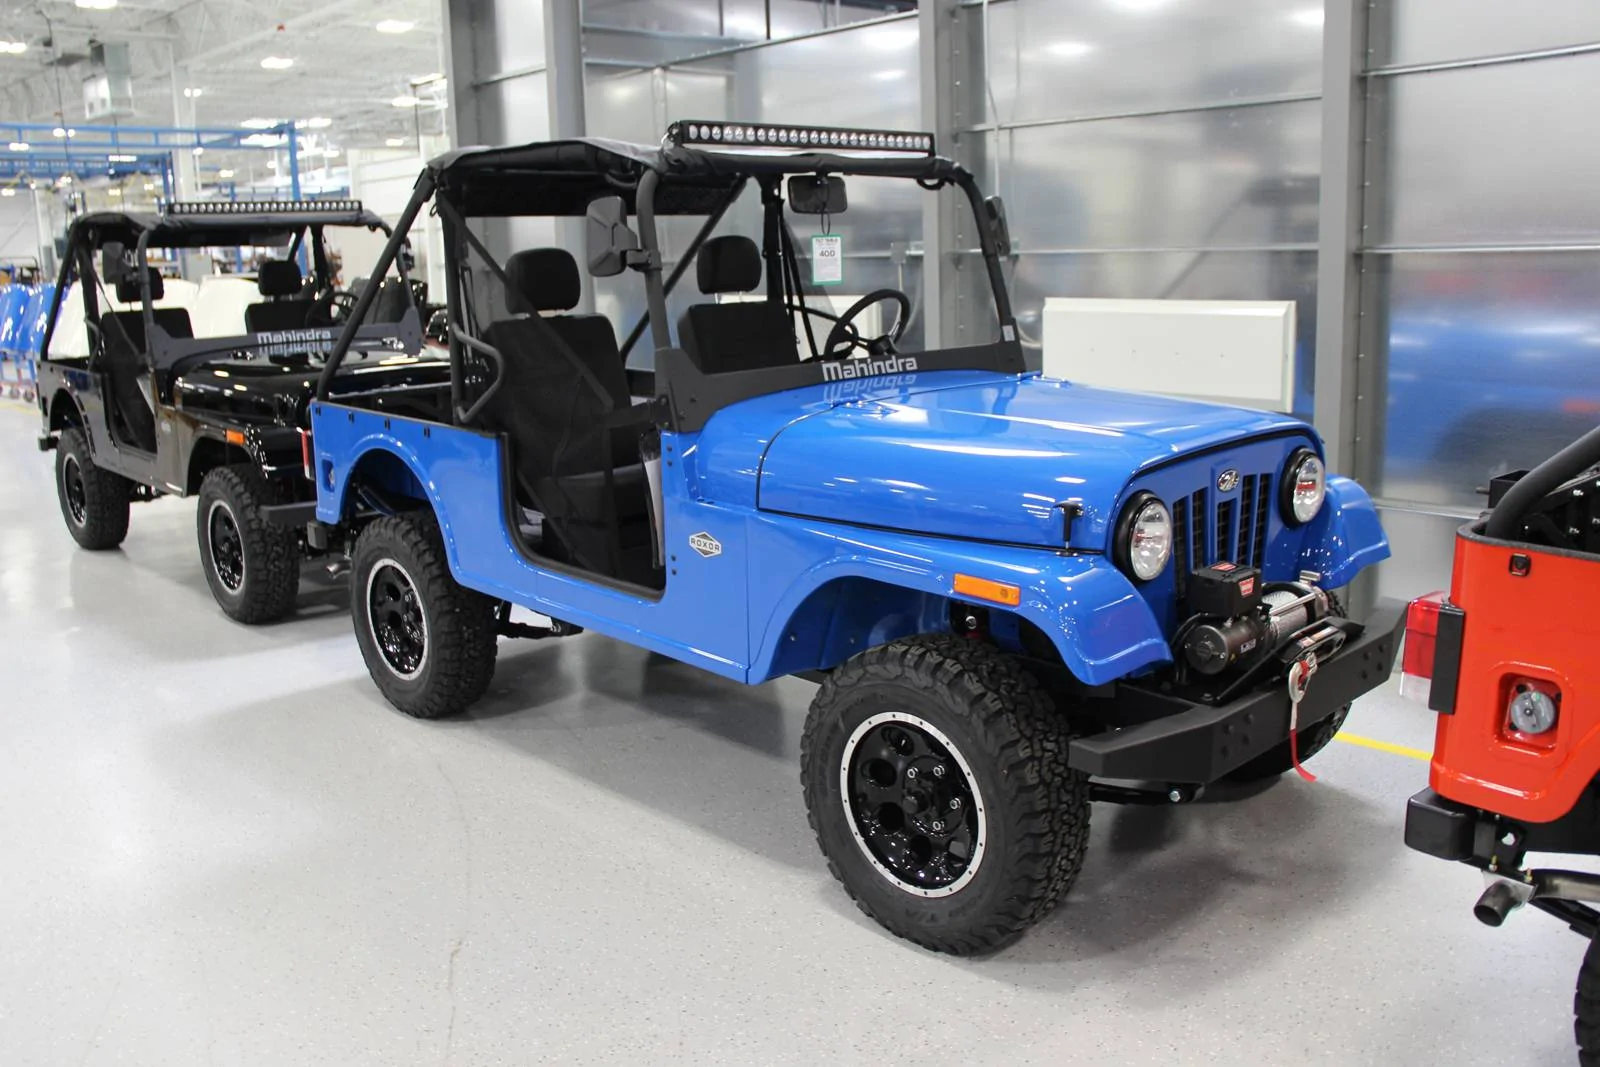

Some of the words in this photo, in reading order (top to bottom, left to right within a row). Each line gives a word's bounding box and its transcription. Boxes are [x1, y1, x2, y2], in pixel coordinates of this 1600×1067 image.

[256, 328, 332, 344] Mahindra
[821, 355, 918, 382] Mahindra
[690, 537, 721, 552] ROXOR
